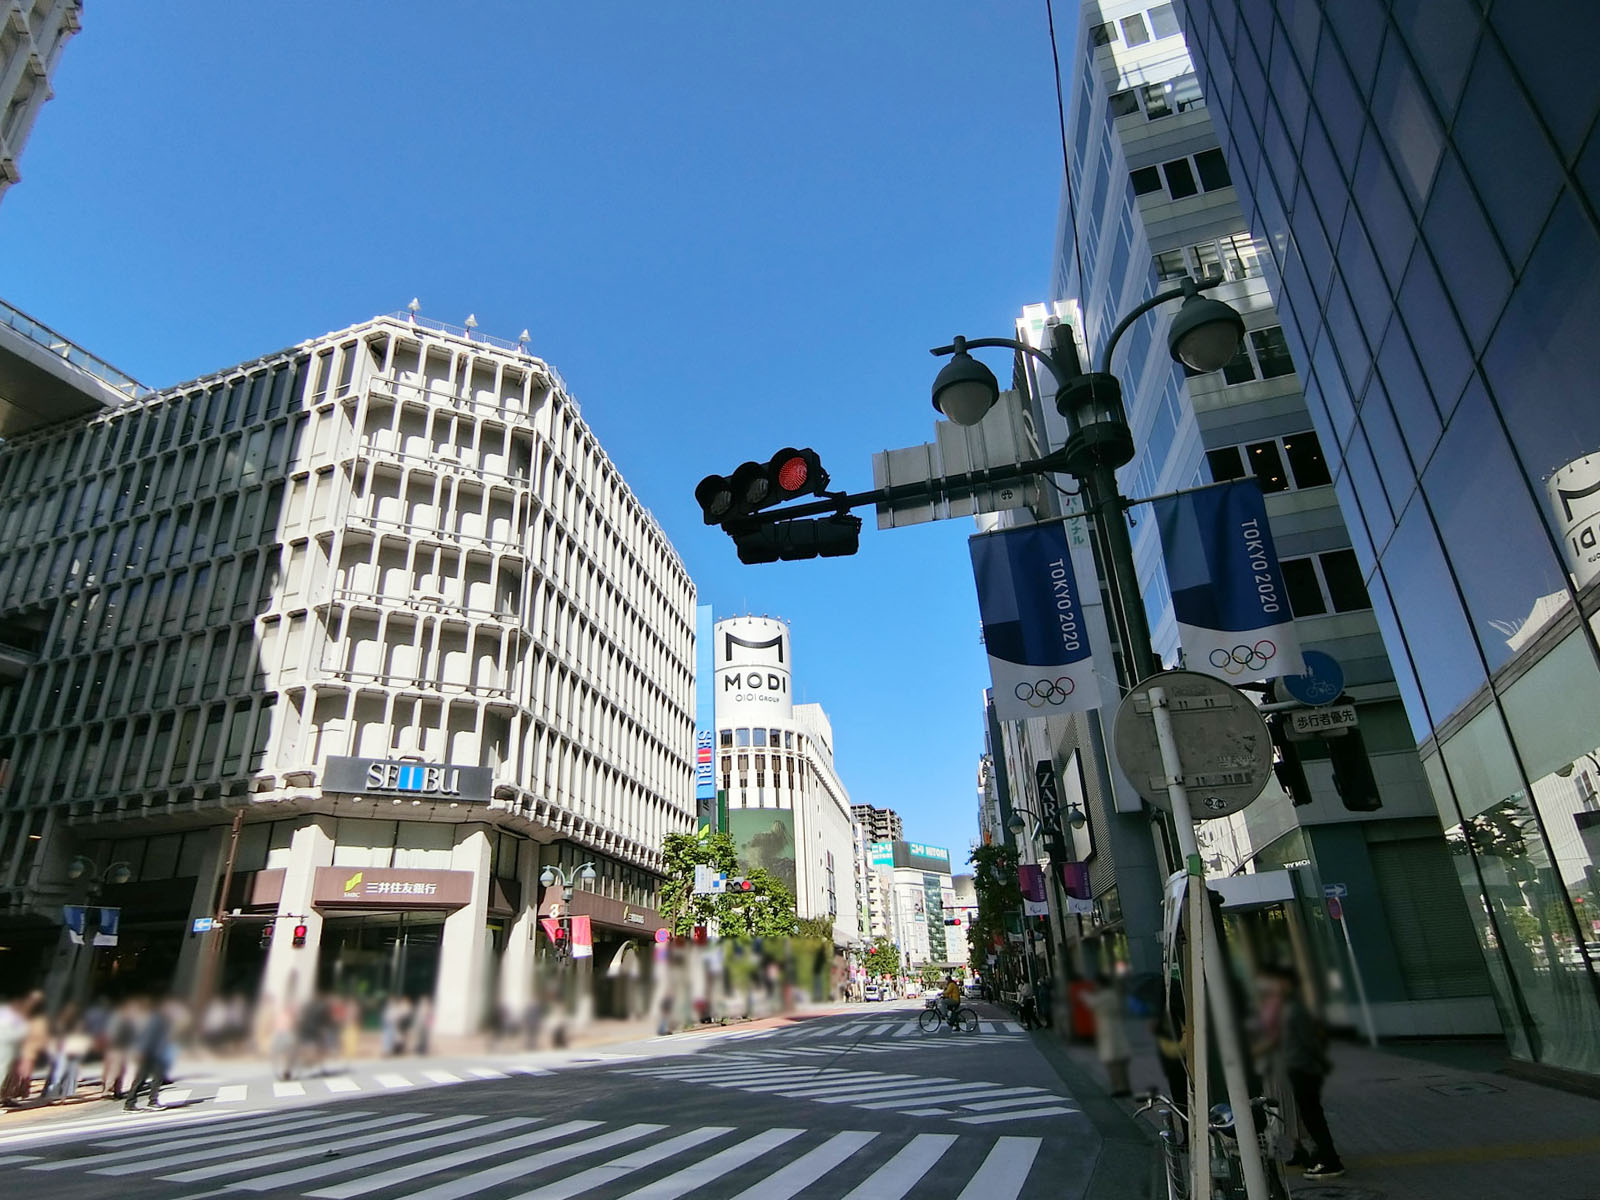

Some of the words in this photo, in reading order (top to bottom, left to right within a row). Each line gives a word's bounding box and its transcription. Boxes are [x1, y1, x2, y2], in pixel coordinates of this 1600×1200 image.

[1241, 518, 1268, 571] TOKYO
[1255, 573, 1280, 613] 2020
[1049, 558, 1072, 610] TOKYO
[1060, 612, 1080, 651] 2020
[725, 672, 786, 694] MODI
[1297, 709, 1355, 728] 歩行者優先
[366, 762, 460, 796] SEIBU
[366, 882, 437, 895] 三井住友銀行
